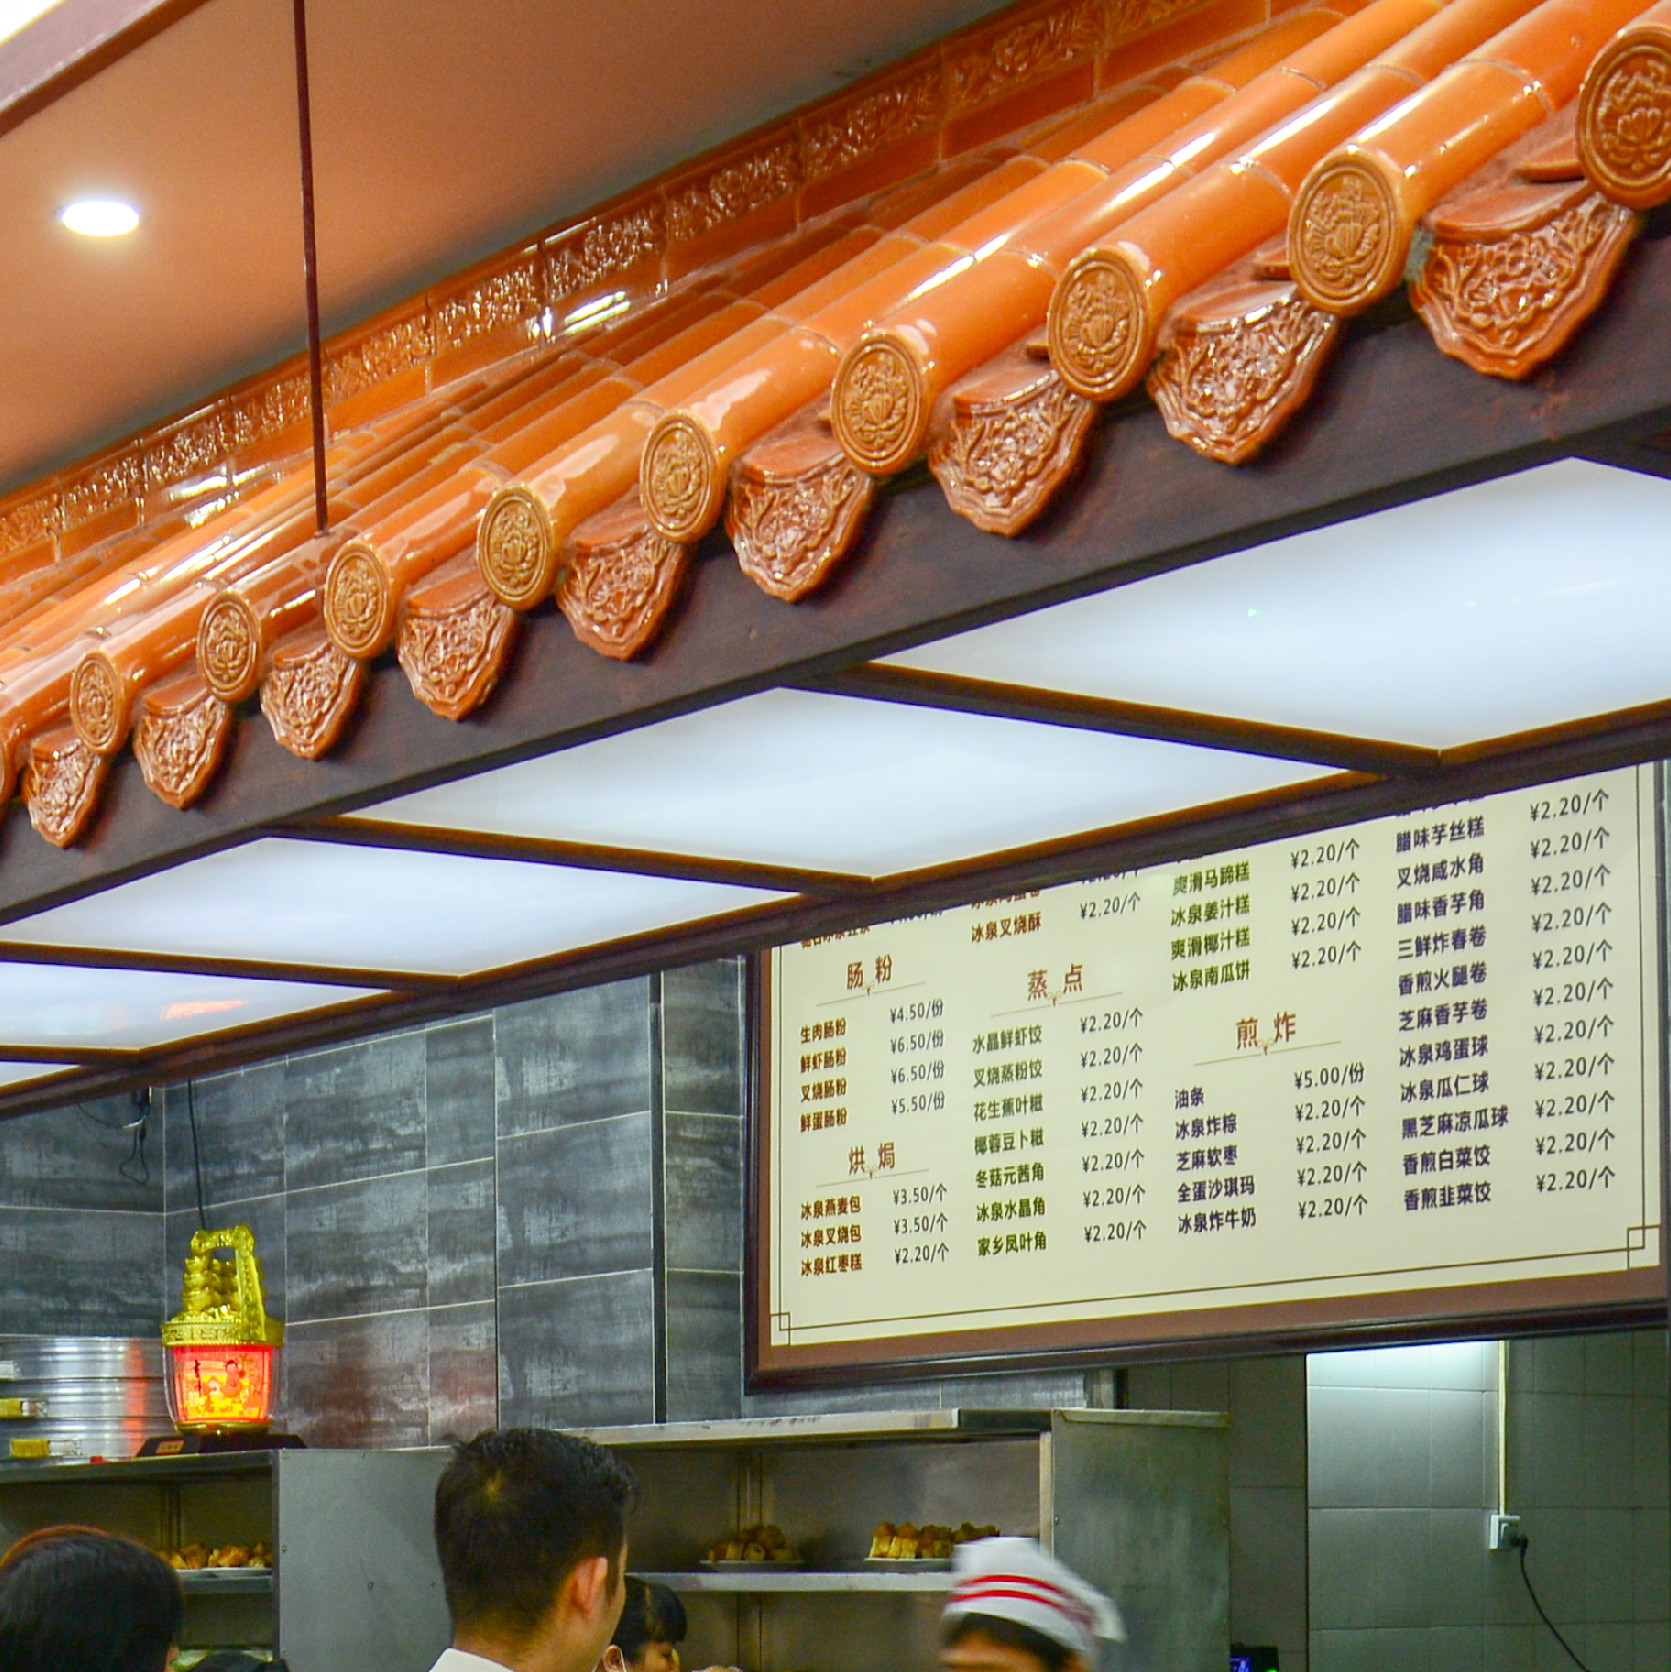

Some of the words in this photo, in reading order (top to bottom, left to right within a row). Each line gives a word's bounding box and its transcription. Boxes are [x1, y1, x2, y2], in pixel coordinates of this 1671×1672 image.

[1396, 816, 1484, 853] 腊味芋丝糕
[1530, 789, 1609, 821] ¥2.20/个
[1173, 861, 1250, 895] 爽滑马蹄糕
[1291, 838, 1360, 869] ¥2.20/个
[1397, 853, 1484, 888] 叉烧咸水角
[1531, 827, 1610, 859] ¥2.20/个
[1171, 894, 1250, 927] 冰泉姜汁糕
[1291, 873, 1360, 903] ¥2.20/个
[1397, 889, 1484, 924] 腊味香芋角
[1531, 864, 1611, 895] ¥2.20/个
[972, 912, 1041, 943] 冰泉叉烧酥
[1080, 892, 1140, 919] ¥2.20/个
[1171, 927, 1250, 960] 爽滑椰汁糕
[1291, 906, 1360, 936] ¥2.20/个
[1398, 925, 1486, 959] 三鲜炸春卷
[1532, 902, 1612, 933] ¥2.20/个
[847, 954, 892, 990] 肠粉
[1027, 963, 1082, 1001] 蒸点
[1173, 959, 1250, 992] 冰泉南瓜饼
[1292, 941, 1361, 969] ¥2.20/个
[1399, 961, 1487, 996] 香煎火腿卷
[1533, 940, 1613, 969] ¥2.20/个
[801, 1018, 846, 1044] 生肉肠粉
[891, 999, 943, 1023] ¥4.50/份
[1399, 998, 1488, 1032] 芝麻香芋卷
[1534, 978, 1614, 1006] ¥2.20/个
[801, 1048, 846, 1073] 鲜虾肠粉
[891, 1030, 944, 1053] ¥6.50/份
[973, 1024, 1042, 1054] 水晶鲜虾饺
[1081, 1008, 1143, 1033] ¥2.20/个
[1237, 1012, 1296, 1049] 煎炸
[1400, 1035, 1488, 1067] 冰泉鸡蛋球
[1534, 1015, 1614, 1044] ¥2.20/个
[801, 1078, 846, 1102] 叉烧肠粉
[892, 1061, 944, 1085] ¥6.50/份
[973, 1059, 1042, 1088] 叉烧蒸粉饺
[1081, 1043, 1142, 1068] ¥2.20/个
[1175, 1087, 1204, 1109] 油条
[1294, 1062, 1364, 1089] ¥5.00/份
[1400, 1071, 1489, 1103] 冰泉瓜仁球
[1535, 1053, 1615, 1081] ¥2.20/个
[801, 1108, 847, 1132] 鲜蛋肠粉
[892, 1091, 945, 1115] ¥5.50/份
[1081, 1078, 1143, 1103] ¥2.20/个
[1295, 1096, 1365, 1121] ¥2.20/个
[1082, 1114, 1144, 1138] ¥2.20/个
[1402, 1105, 1508, 1139] 黑芝麻凉瓜球
[1535, 1090, 1615, 1118] ¥2.20/个
[849, 1142, 895, 1175] 烘焗
[1082, 1149, 1145, 1173] ¥2.20/个
[1177, 1145, 1237, 1171] 芝麻软枣
[1296, 1128, 1366, 1154] ¥2.20/个
[1403, 1145, 1490, 1176] 香煎白菜饺
[1536, 1129, 1615, 1155] ¥2.20/个
[801, 1196, 861, 1220] 冰泉燕麦包
[893, 1184, 947, 1205] ¥3.50/个
[976, 1197, 1045, 1221] 冰泉水晶角
[1083, 1185, 1146, 1208] ¥2.20/个
[1178, 1175, 1255, 1203] 全蛋沙琪玛
[1297, 1161, 1367, 1186] ¥2.20/个
[1404, 1181, 1491, 1211] 香煎韭菜饺
[1536, 1166, 1615, 1192] ¥2.20/个
[801, 1225, 862, 1248] 冰泉叉烧包
[894, 1213, 948, 1234] ¥3.50/个
[1084, 1220, 1147, 1243] ¥2.20/个
[1179, 1208, 1256, 1234] 冰泉炸牛奶
[1298, 1194, 1368, 1219] ¥2.20/个
[801, 1254, 862, 1276] 冰泉红枣糕
[895, 1243, 949, 1264] ¥2.20/个
